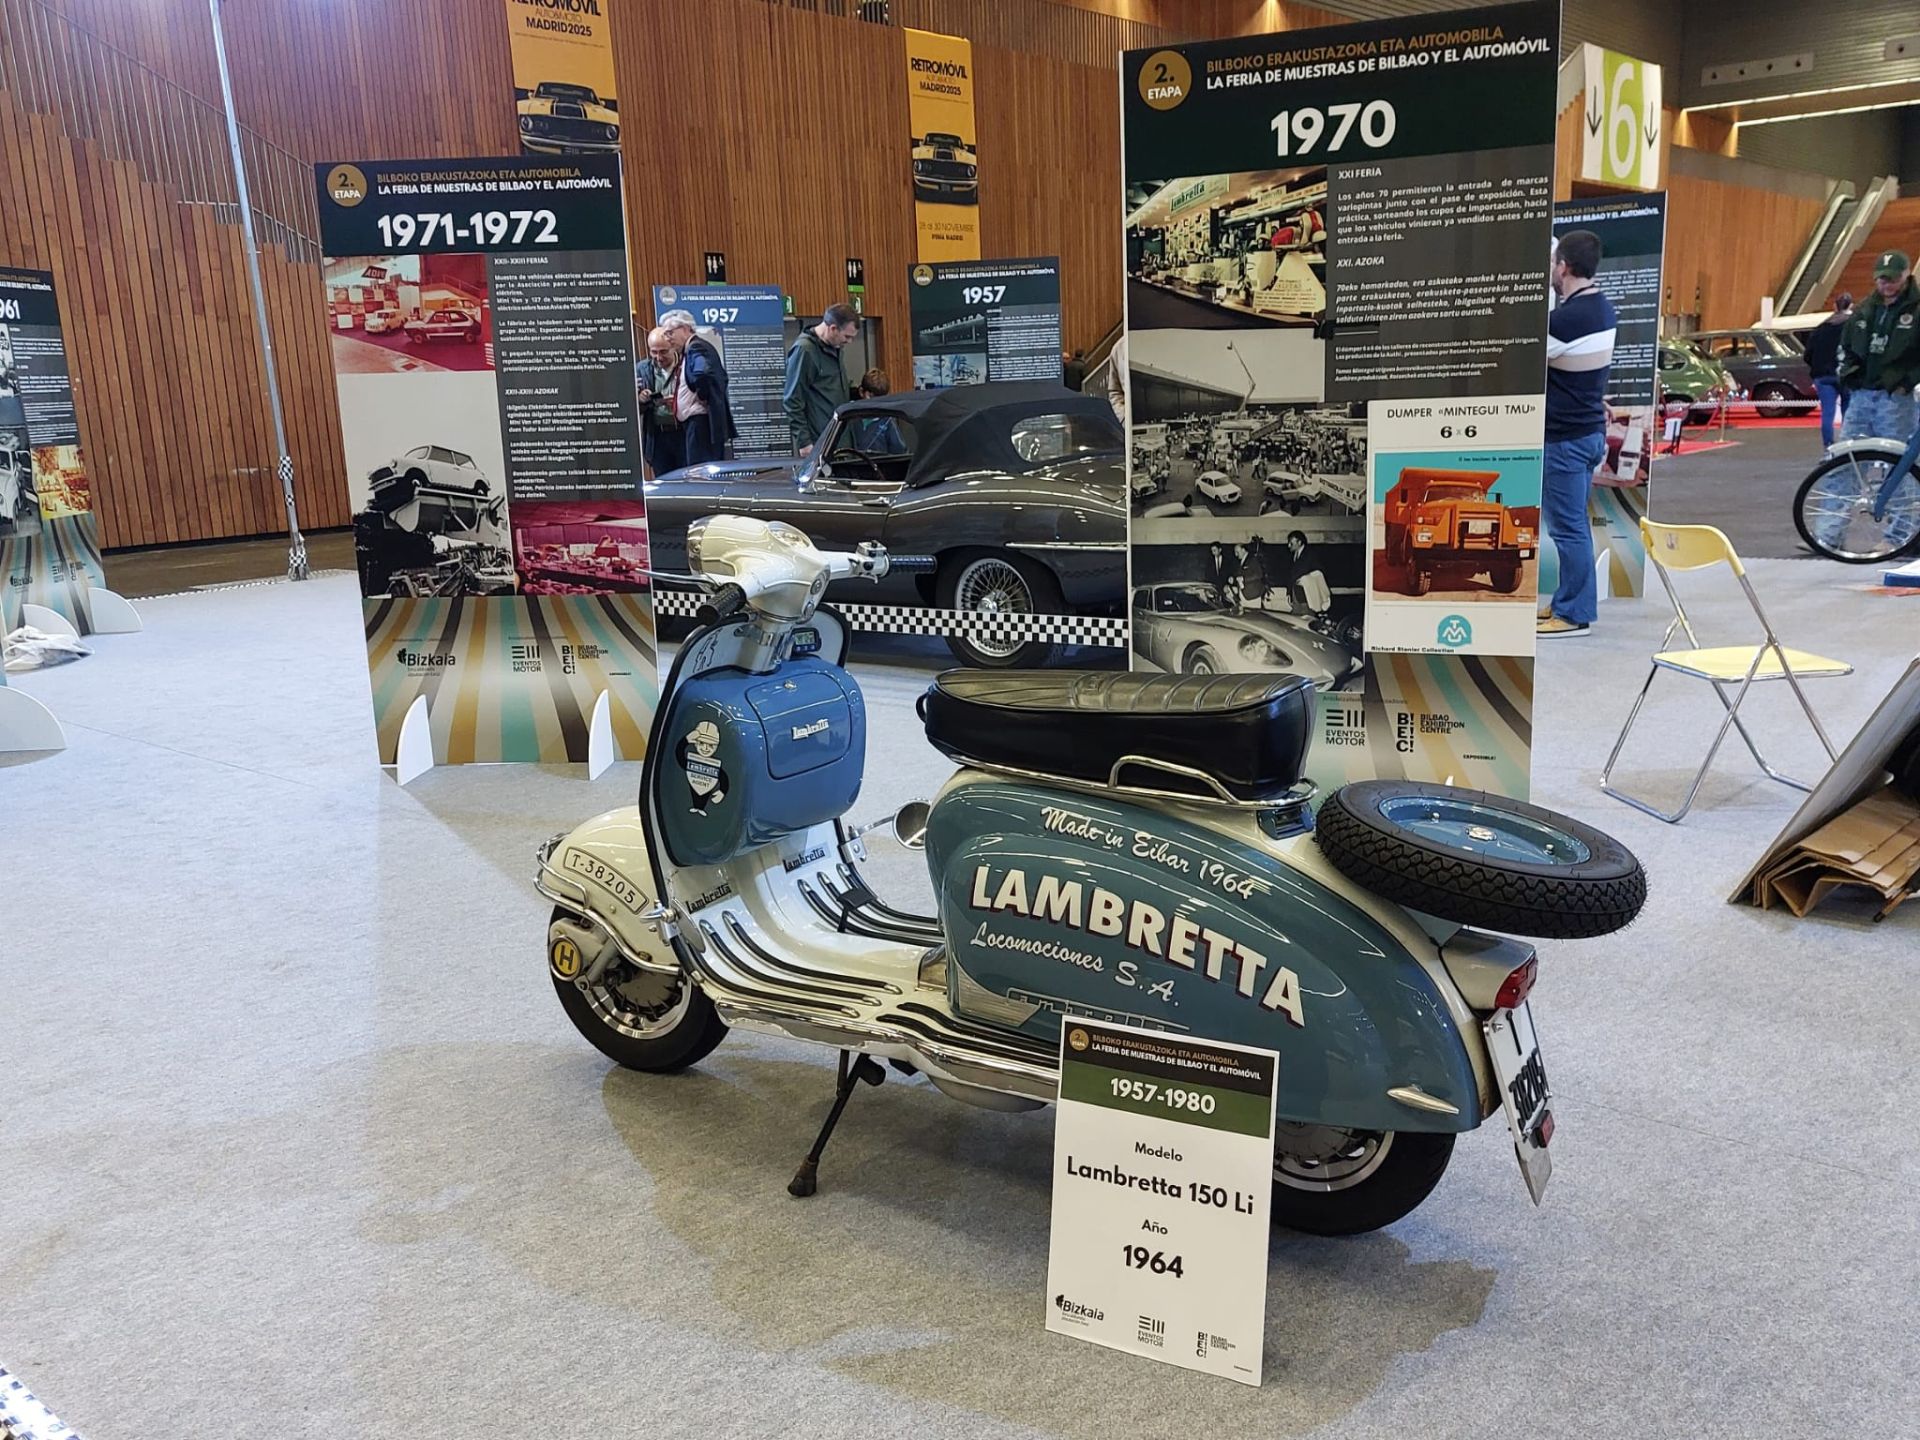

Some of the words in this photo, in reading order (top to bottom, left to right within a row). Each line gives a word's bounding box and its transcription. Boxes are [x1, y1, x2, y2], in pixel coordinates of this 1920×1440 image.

[1206, 54, 1263, 72] BILBOKO
[1267, 41, 1376, 65] ERAKUSTAZOKA
[1380, 37, 1405, 52] ETA
[1408, 26, 1503, 48] AUTOMOBILA
[911, 57, 968, 80] RETROMÓVIL
[1206, 76, 1223, 89] LA
[1225, 71, 1262, 87] FERIA
[1264, 68, 1281, 83] DE
[1284, 60, 1355, 80] MUESTRAS
[1358, 57, 1375, 72] DE
[1378, 52, 1429, 70] BILBAO
[1430, 49, 1441, 63] Y
[1444, 48, 1459, 62] EL
[1462, 38, 1549, 60] AUTOMÓVIL
[1155, 64, 1175, 84] 2.
[1148, 85, 1182, 100] ETAPA
[1271, 100, 1395, 155] 1970
[1608, 62, 1637, 179] 6
[376, 172, 418, 183] BILBOKO
[420, 170, 497, 181] ERAKUSTAZOKA
[498, 169, 516, 179] ETA
[518, 167, 580, 178] AUTOMOBILA
[1338, 169, 1353, 179] XXI
[1355, 167, 1381, 177] FERIA
[334, 189, 361, 199] ETAPA
[377, 185, 391, 194] LA
[392, 184, 418, 194] FERIA
[419, 183, 432, 193] DE
[433, 182, 483, 192] MUESTRAS
[485, 181, 497, 191] DE
[498, 180, 533, 190] BILBAO
[533, 180, 541, 189] Y
[542, 179, 554, 189] EL
[555, 177, 611, 189] AUTOMÓVIL
[1337, 193, 1351, 201] Los
[1355, 190, 1374, 199] años
[1378, 188, 1388, 197] 70
[1391, 185, 1442, 197] permitieron
[1445, 183, 1454, 191] la
[1457, 180, 1492, 190] entrada
[1501, 178, 1512, 186] de
[1516, 176, 1548, 185] marcas
[1384, 199, 1407, 209] junto
[1429, 195, 1437, 204] el
[1464, 192, 1475, 201] de
[1529, 187, 1548, 195] Esta
[1373, 209, 1414, 219] sorteando
[1415, 207, 1428, 216] los
[1429, 207, 1454, 216] cupos
[1455, 204, 1466, 213] de
[1620, 207, 1659, 218] AUTOMÓVIL
[378, 210, 557, 246] 1971-1972
[1337, 226, 1352, 235] que
[1354, 224, 1366, 232] los
[1368, 221, 1406, 230] vehículos
[1408, 219, 1441, 227] vinieran
[1444, 218, 1454, 227] ya
[1457, 214, 1494, 224] vendidos
[1496, 212, 1520, 221] antes
[1522, 210, 1534, 219] de
[1536, 210, 1547, 218] su
[1337, 235, 1368, 244] entrada
[1374, 233, 1382, 241] la
[1336, 258, 1353, 267] XXI.
[1354, 256, 1384, 266] AZOKA
[962, 286, 1006, 304] 1957
[702, 308, 739, 323] 1957
[1387, 407, 1431, 418] DUMPER
[1438, 405, 1498, 416] «MINTEGUI
[1504, 404, 1535, 414] TMU»
[1440, 425, 1452, 438] 6
[1464, 425, 1477, 438] 6
[408, 653, 456, 667] Bizkaia
[792, 718, 830, 740] Lambretta
[1397, 712, 1414, 726] B!
[1326, 730, 1365, 738] EVENTOS
[1326, 737, 1365, 746] MOTOR
[784, 847, 826, 873] Lambretta
[1040, 806, 1100, 841] Made
[1102, 827, 1125, 850] in
[1132, 831, 1190, 873] Eibar
[1199, 859, 1257, 900] 1964
[571, 853, 636, 904] T-38205
[686, 884, 732, 914] Lambretta
[969, 866, 1305, 1027] LAMBRETTA
[970, 921, 1105, 973] Locomociones
[1092, 1034, 1121, 1045] BILBOKO
[1122, 1039, 1176, 1055] ERAKUSTAZOKA
[1177, 1049, 1190, 1058] ETA
[1192, 1052, 1238, 1066] AUTOMOBILA
[1091, 1042, 1100, 1050] LA
[1101, 1044, 1119, 1054] FERIA
[1120, 1048, 1129, 1056] DE
[1130, 1050, 1165, 1062] MUESTRAS
[1166, 1056, 1175, 1064] DE
[1176, 1058, 1202, 1069] BILBAO
[1209, 1063, 1217, 1072] EL
[1218, 1066, 1260, 1079] AUTOMÓVIL
[1111, 1078, 1215, 1113] 1957-1980
[1135, 1142, 1183, 1162] Modelo
[1067, 1155, 1181, 1197] Lambretta
[1188, 1182, 1227, 1207] 150
[1234, 1191, 1253, 1214] Li
[1141, 1219, 1168, 1235] Año
[1123, 1244, 1183, 1278] 1964
[1062, 1300, 1104, 1321] Bizkaia
[1138, 1330, 1164, 1342] EVENTOS
[1138, 1336, 1164, 1348] MOTOR
